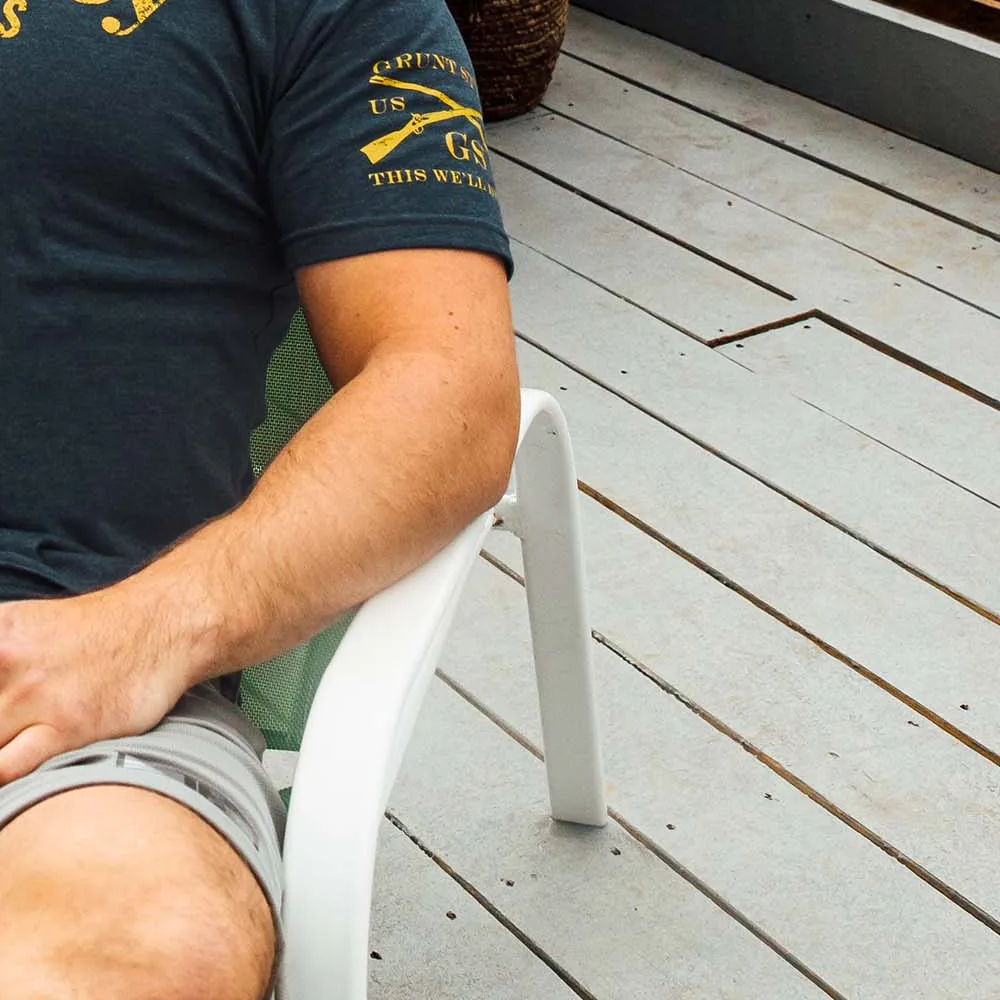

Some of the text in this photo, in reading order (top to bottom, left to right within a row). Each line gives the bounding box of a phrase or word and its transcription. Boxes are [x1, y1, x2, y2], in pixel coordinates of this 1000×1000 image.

[372, 52, 457, 75] GRUNT
[368, 96, 406, 115] US
[445, 131, 487, 169] GS
[368, 168, 428, 187] THIS
[432, 168, 487, 192] WE'LL
